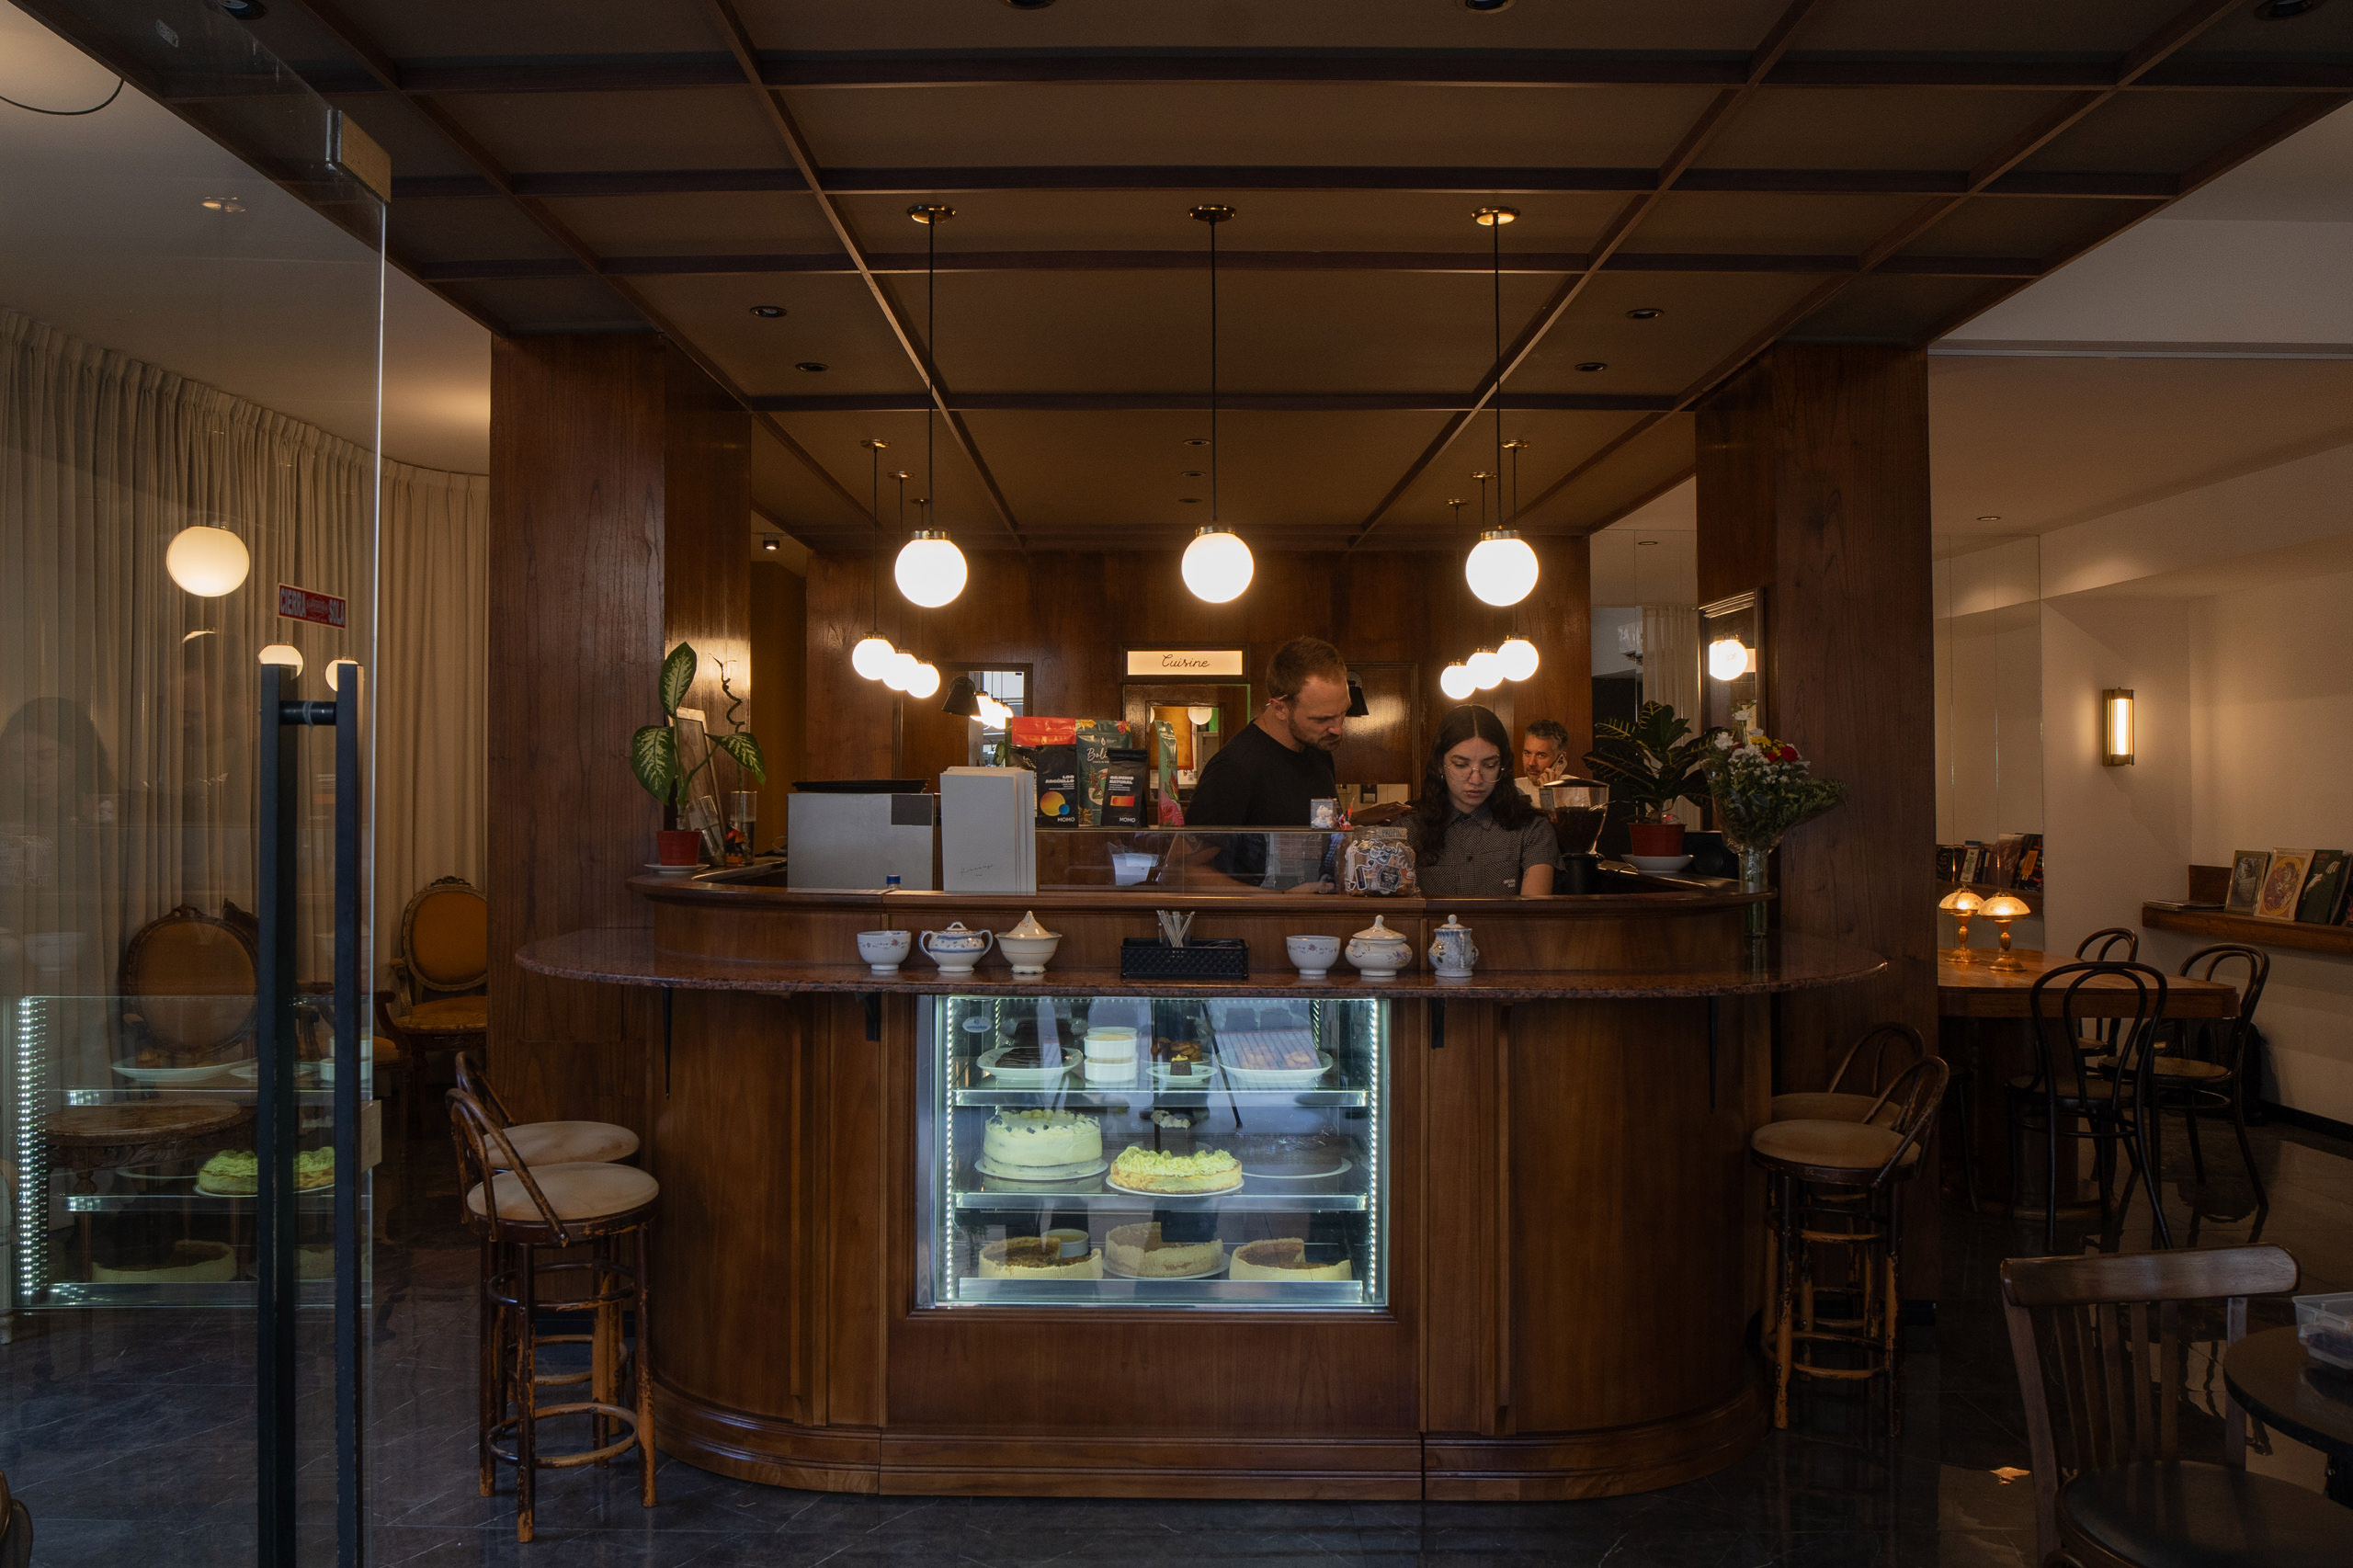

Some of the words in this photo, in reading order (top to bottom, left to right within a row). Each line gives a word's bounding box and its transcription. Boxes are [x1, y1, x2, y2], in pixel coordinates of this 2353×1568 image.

[280, 588, 306, 618] CIERRA
[329, 599, 345, 625] SOLA
[1162, 654, 1210, 667] Cuisine
